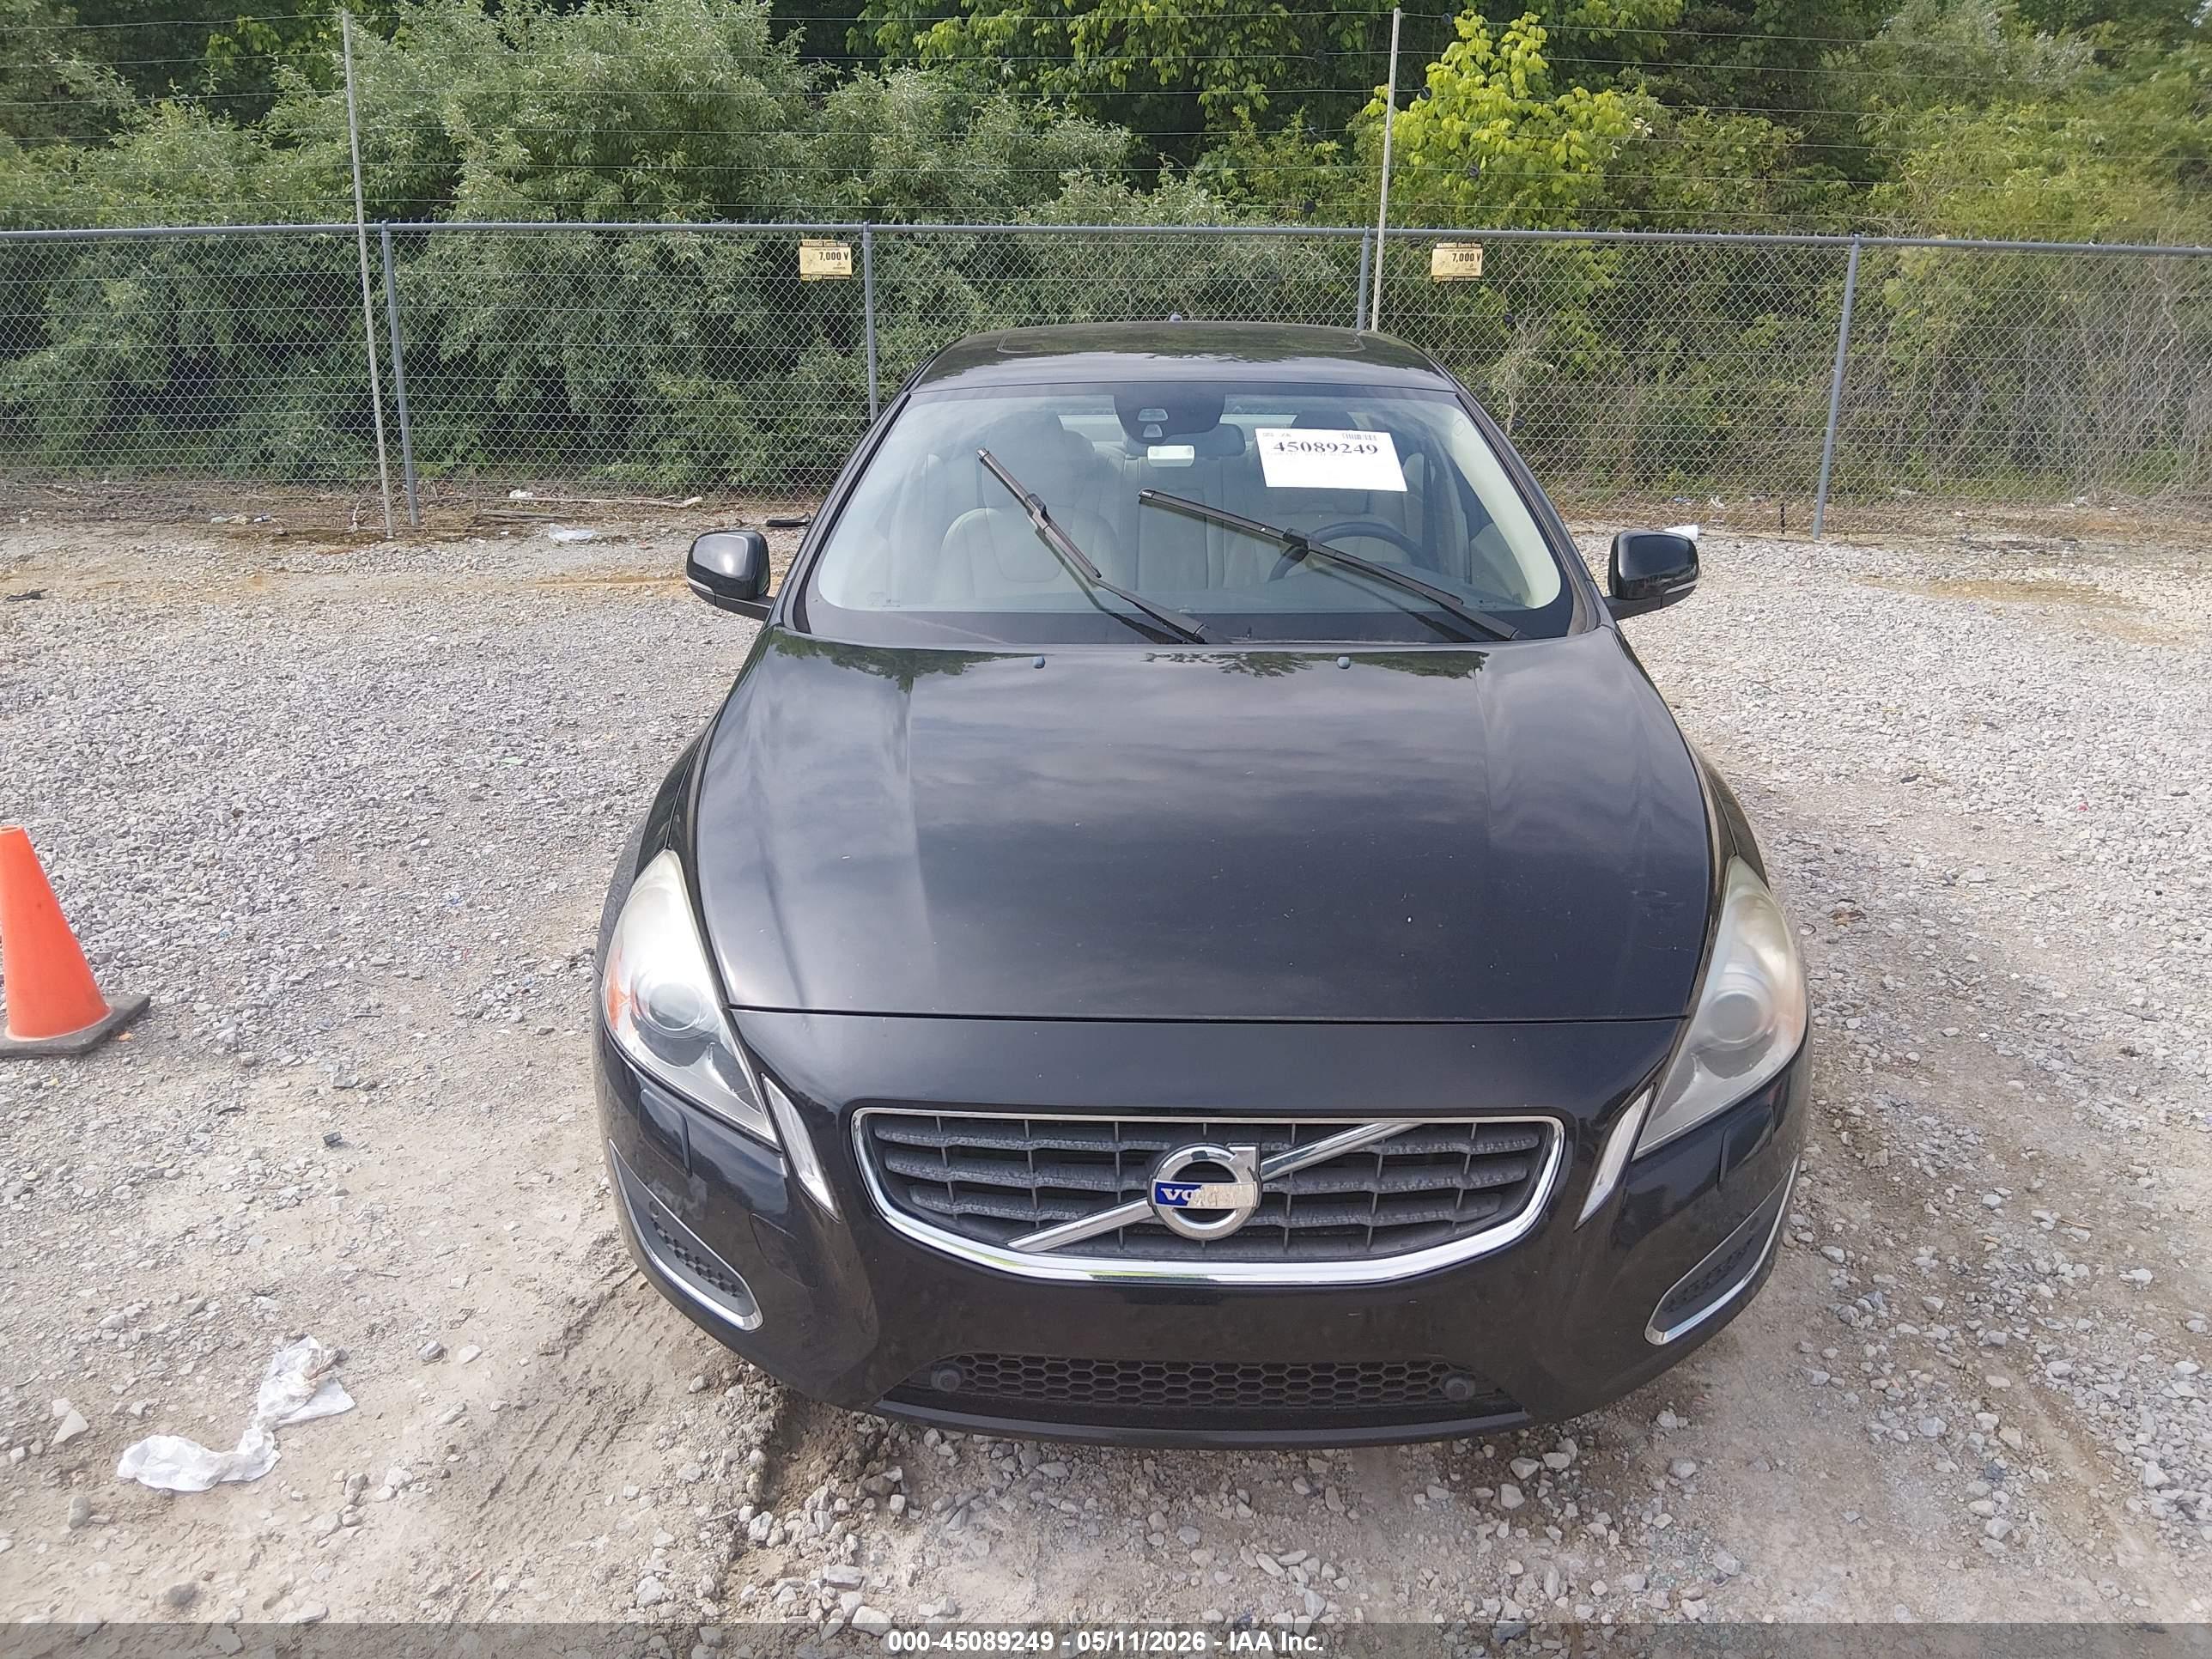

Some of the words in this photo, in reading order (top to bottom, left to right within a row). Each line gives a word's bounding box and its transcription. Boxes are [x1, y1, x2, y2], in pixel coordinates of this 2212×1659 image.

[818, 252, 842, 261] 7,000
[843, 252, 849, 260] V
[1451, 252, 1474, 263] 7,000
[1476, 252, 1481, 262] V
[1273, 441, 1378, 454] 45089249
